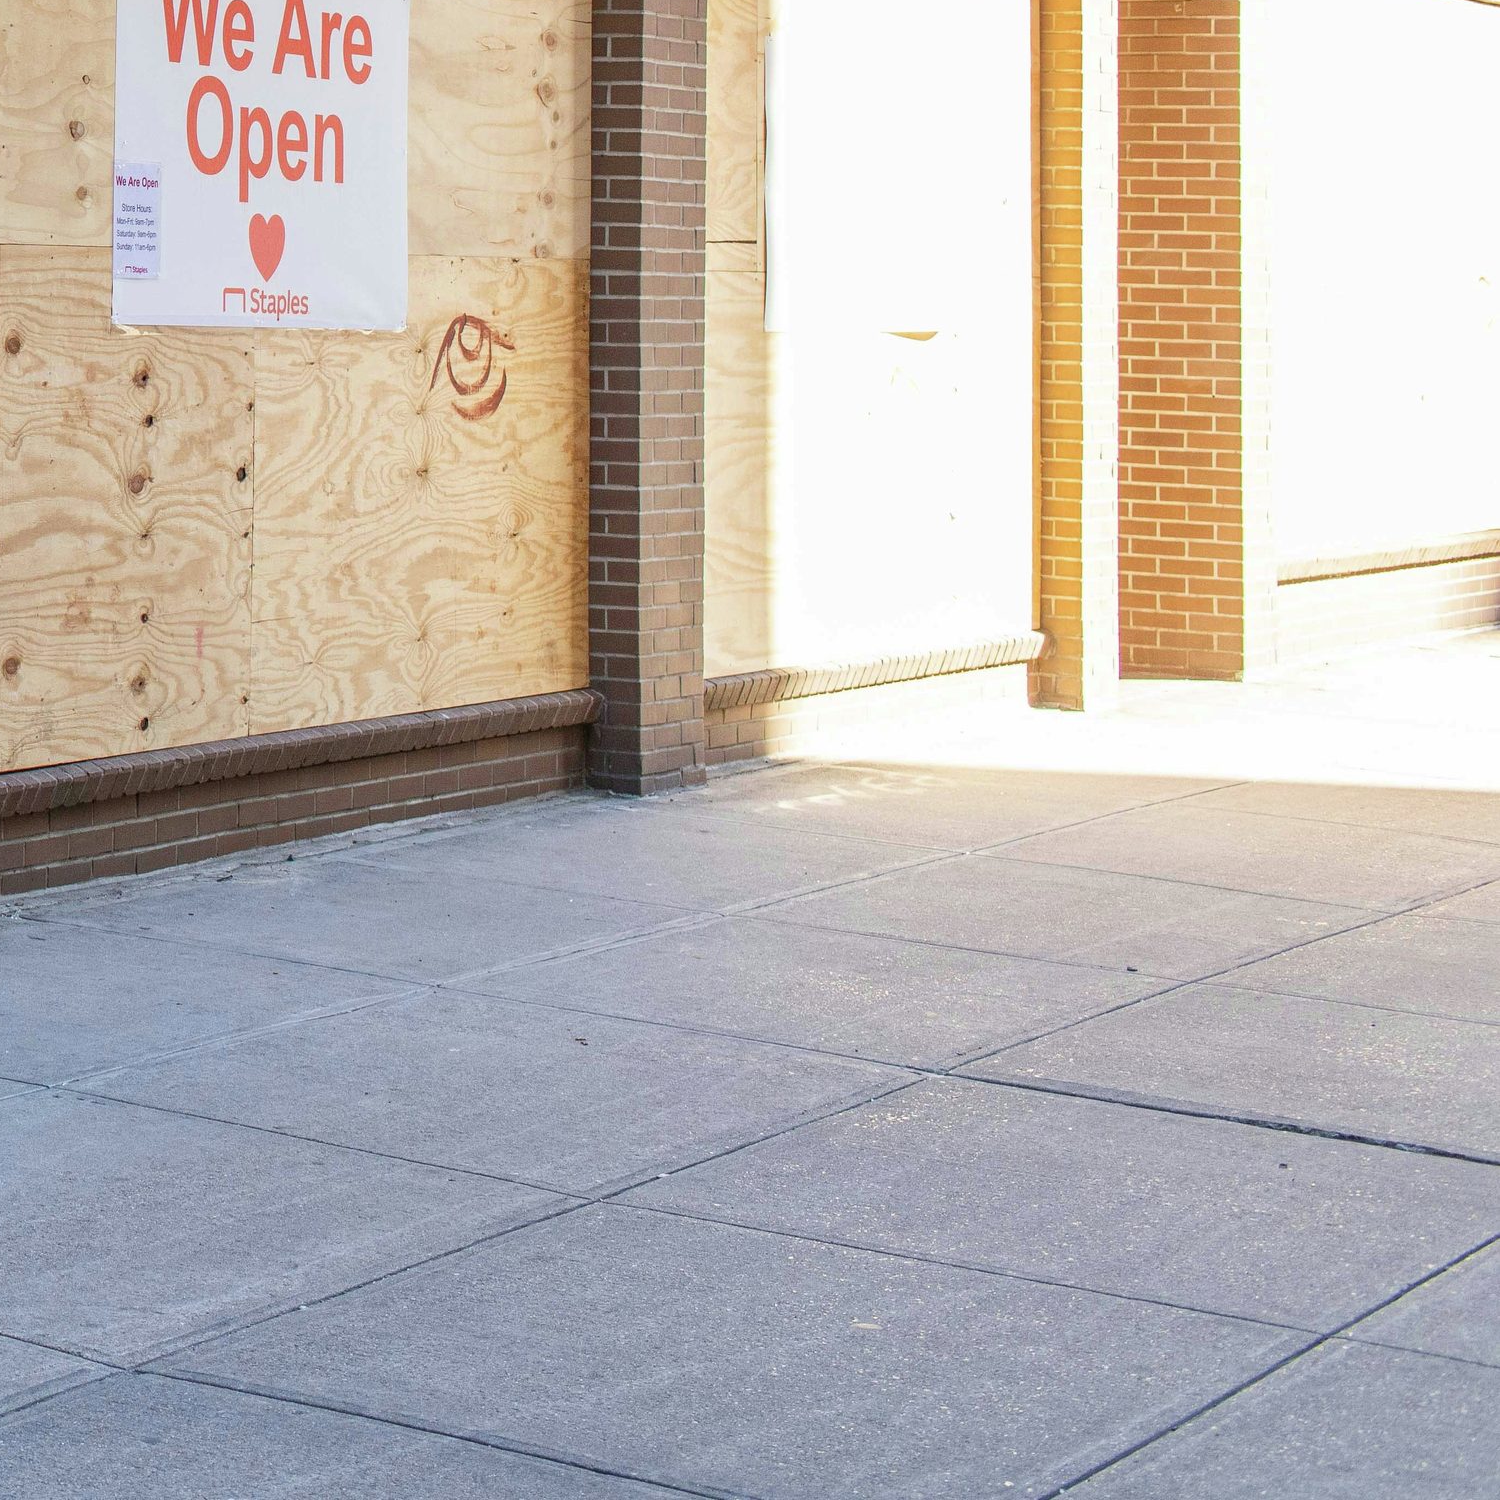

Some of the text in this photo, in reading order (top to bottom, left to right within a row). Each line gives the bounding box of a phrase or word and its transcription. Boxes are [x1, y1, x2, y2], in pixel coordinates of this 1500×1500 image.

[186, 75, 344, 203] Open
[116, 175, 159, 190] We Are Open
[121, 203, 153, 214] Store Hours:
[132, 266, 148, 274] Staples
[249, 286, 310, 322] Staples
